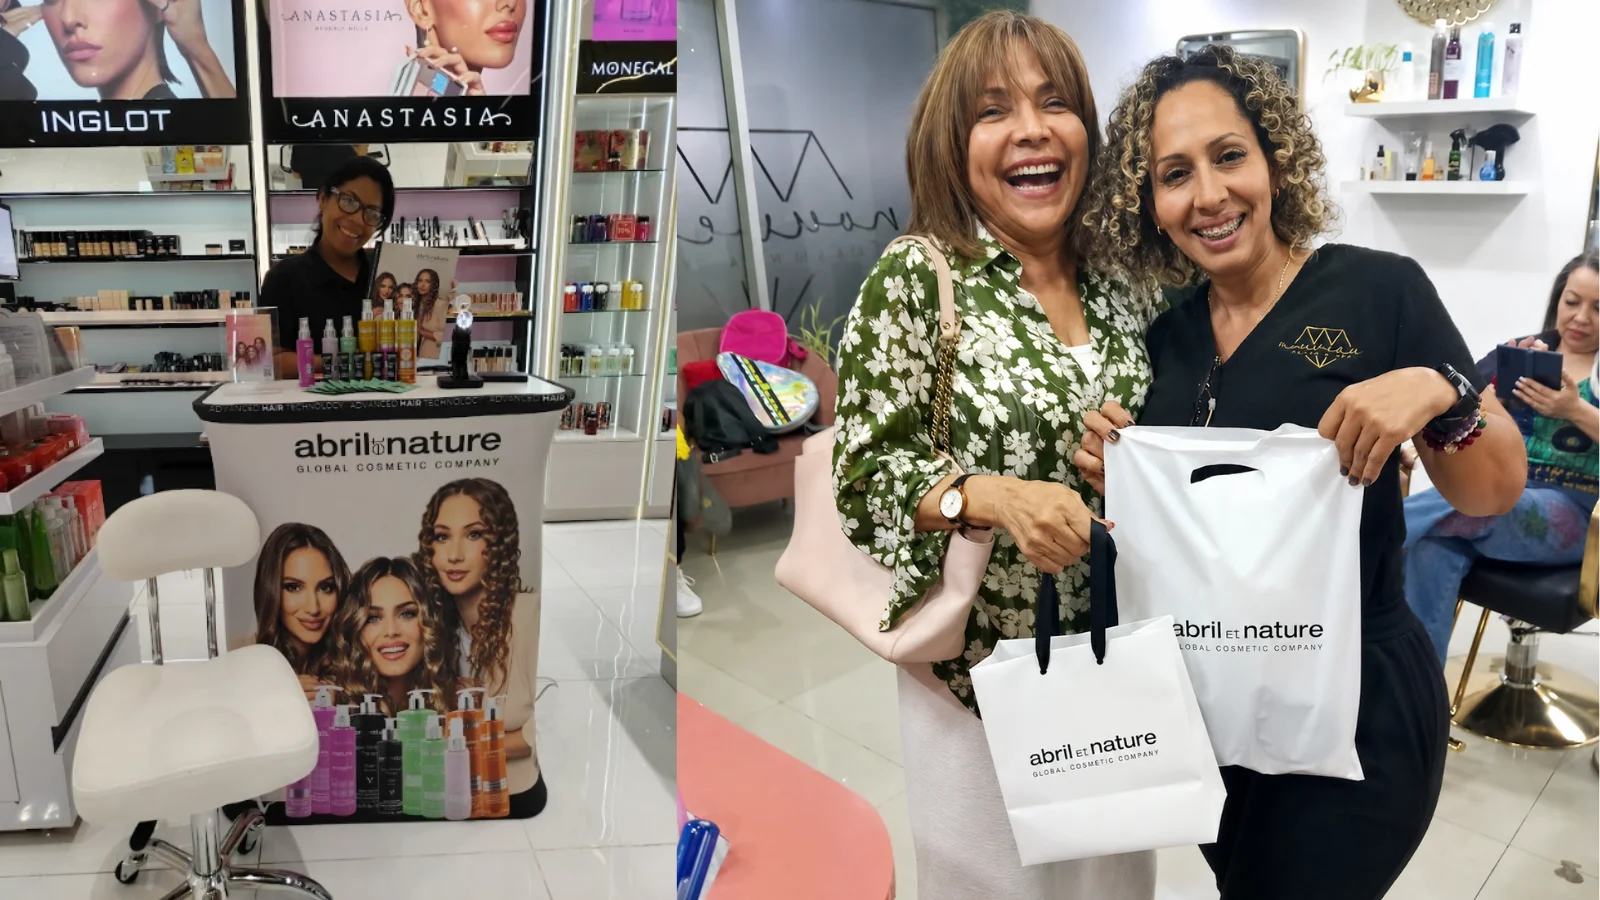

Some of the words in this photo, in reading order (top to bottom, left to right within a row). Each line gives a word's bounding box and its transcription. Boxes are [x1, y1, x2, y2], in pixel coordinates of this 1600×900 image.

[281, 10, 402, 22] ANASTASIA
[591, 61, 674, 76] MONEGAL
[41, 109, 172, 133] INGLOT
[292, 107, 512, 129] ANASTASIA
[209, 404, 260, 413] ADVANCED
[261, 403, 284, 412] HAIR
[350, 400, 398, 409] ADVANCED
[400, 399, 422, 407] HAIR
[424, 396, 479, 407] TECHNOLOG
[490, 395, 540, 403] ADVANCED
[542, 393, 565, 402] HAIR
[294, 432, 370, 458] abril
[387, 431, 501, 455] nature
[296, 464, 349, 473] GLOBAL
[356, 460, 428, 472] COSMETIC
[434, 457, 500, 469] COMPANY
[1173, 620, 1222, 638] abril
[1244, 621, 1324, 639] nature
[1179, 643, 1211, 652] LOBAL
[1273, 643, 1324, 652] COMPANY
[1029, 743, 1073, 766] abril
[1089, 732, 1157, 755] nature
[1032, 766, 1067, 778] GLOBAL
[1069, 757, 1115, 771] COSMETIC
[1117, 748, 1160, 762] COMPANY
